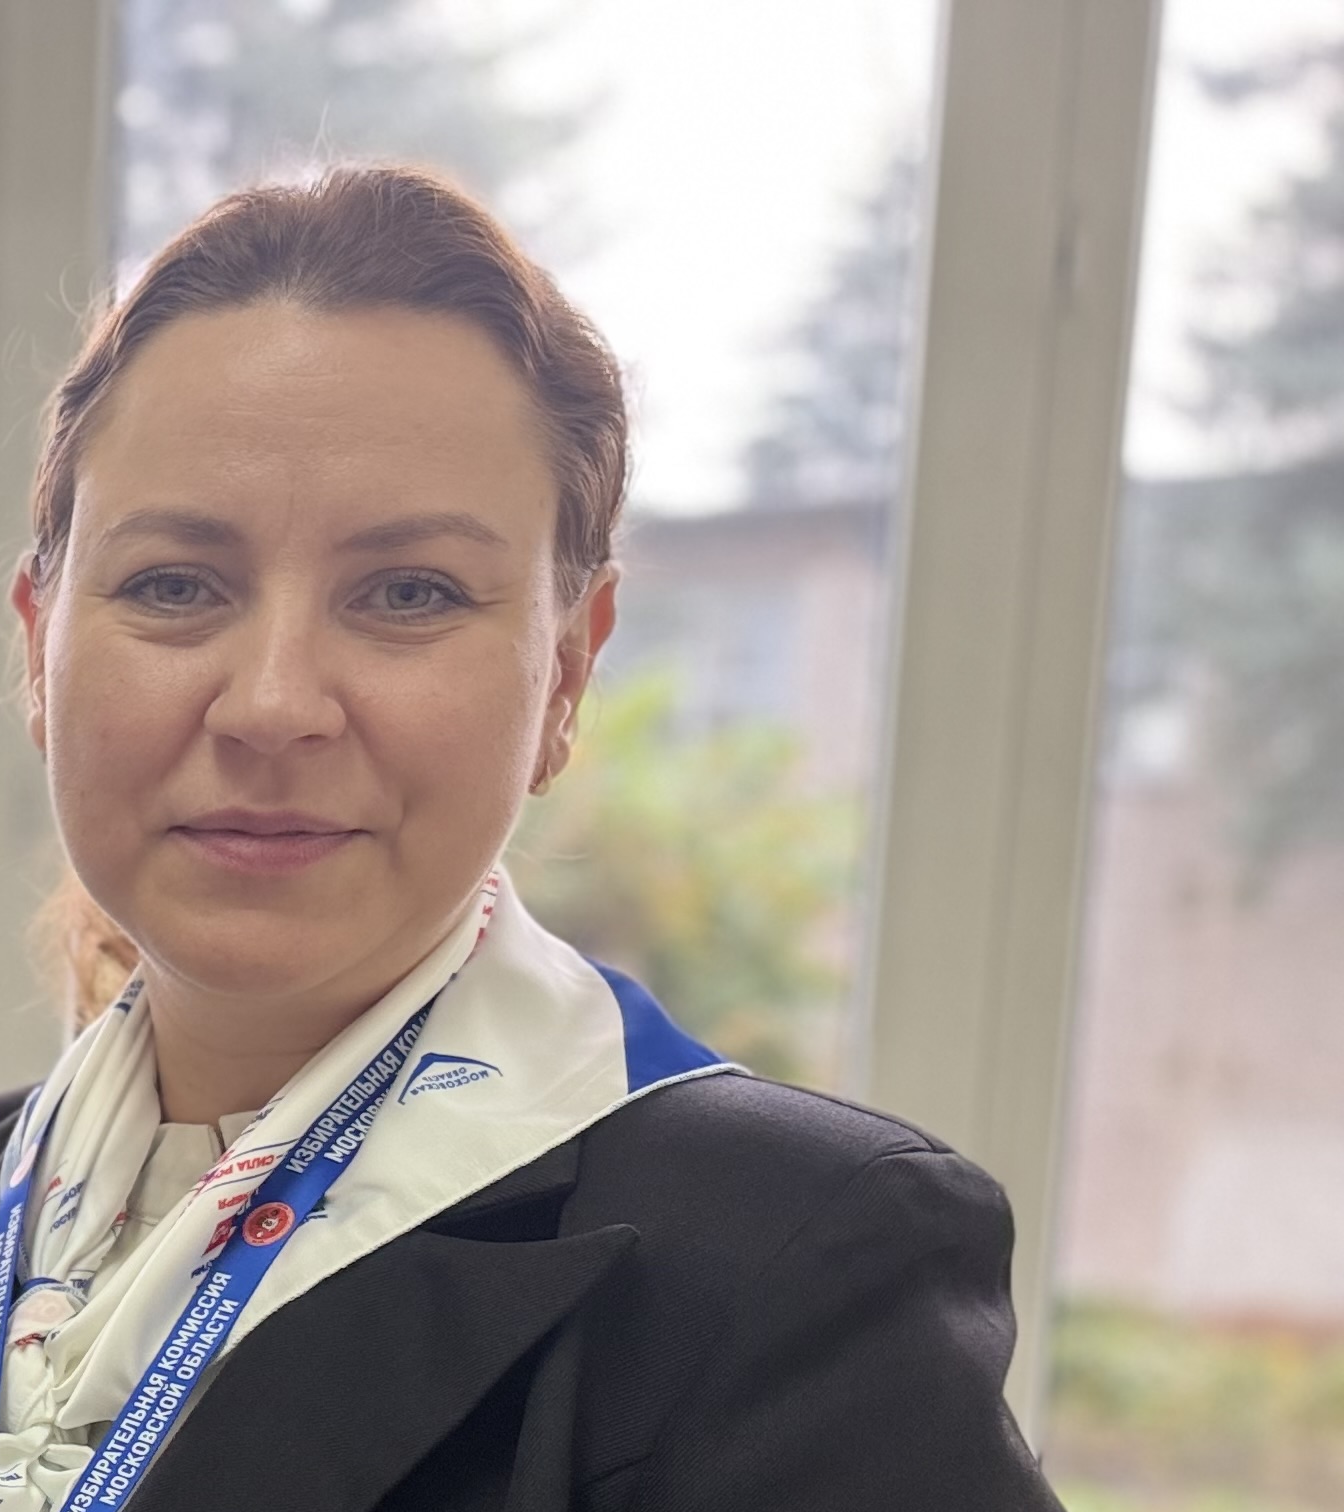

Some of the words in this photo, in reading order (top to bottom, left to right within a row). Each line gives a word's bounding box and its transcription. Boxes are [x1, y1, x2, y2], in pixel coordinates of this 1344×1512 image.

[285, 1051, 401, 1174] ИЗБИРАТЕЛЬНАЯ
[410, 1069, 490, 1096] МОСКОВСКАЯ
[422, 1066, 468, 1082] ОБЛАСТЬ
[158, 1271, 232, 1371] КОМИССИЯ
[98, 1382, 187, 1506] МОСКОВСКОЙ
[176, 1299, 240, 1381] ОБЛАСТИ
